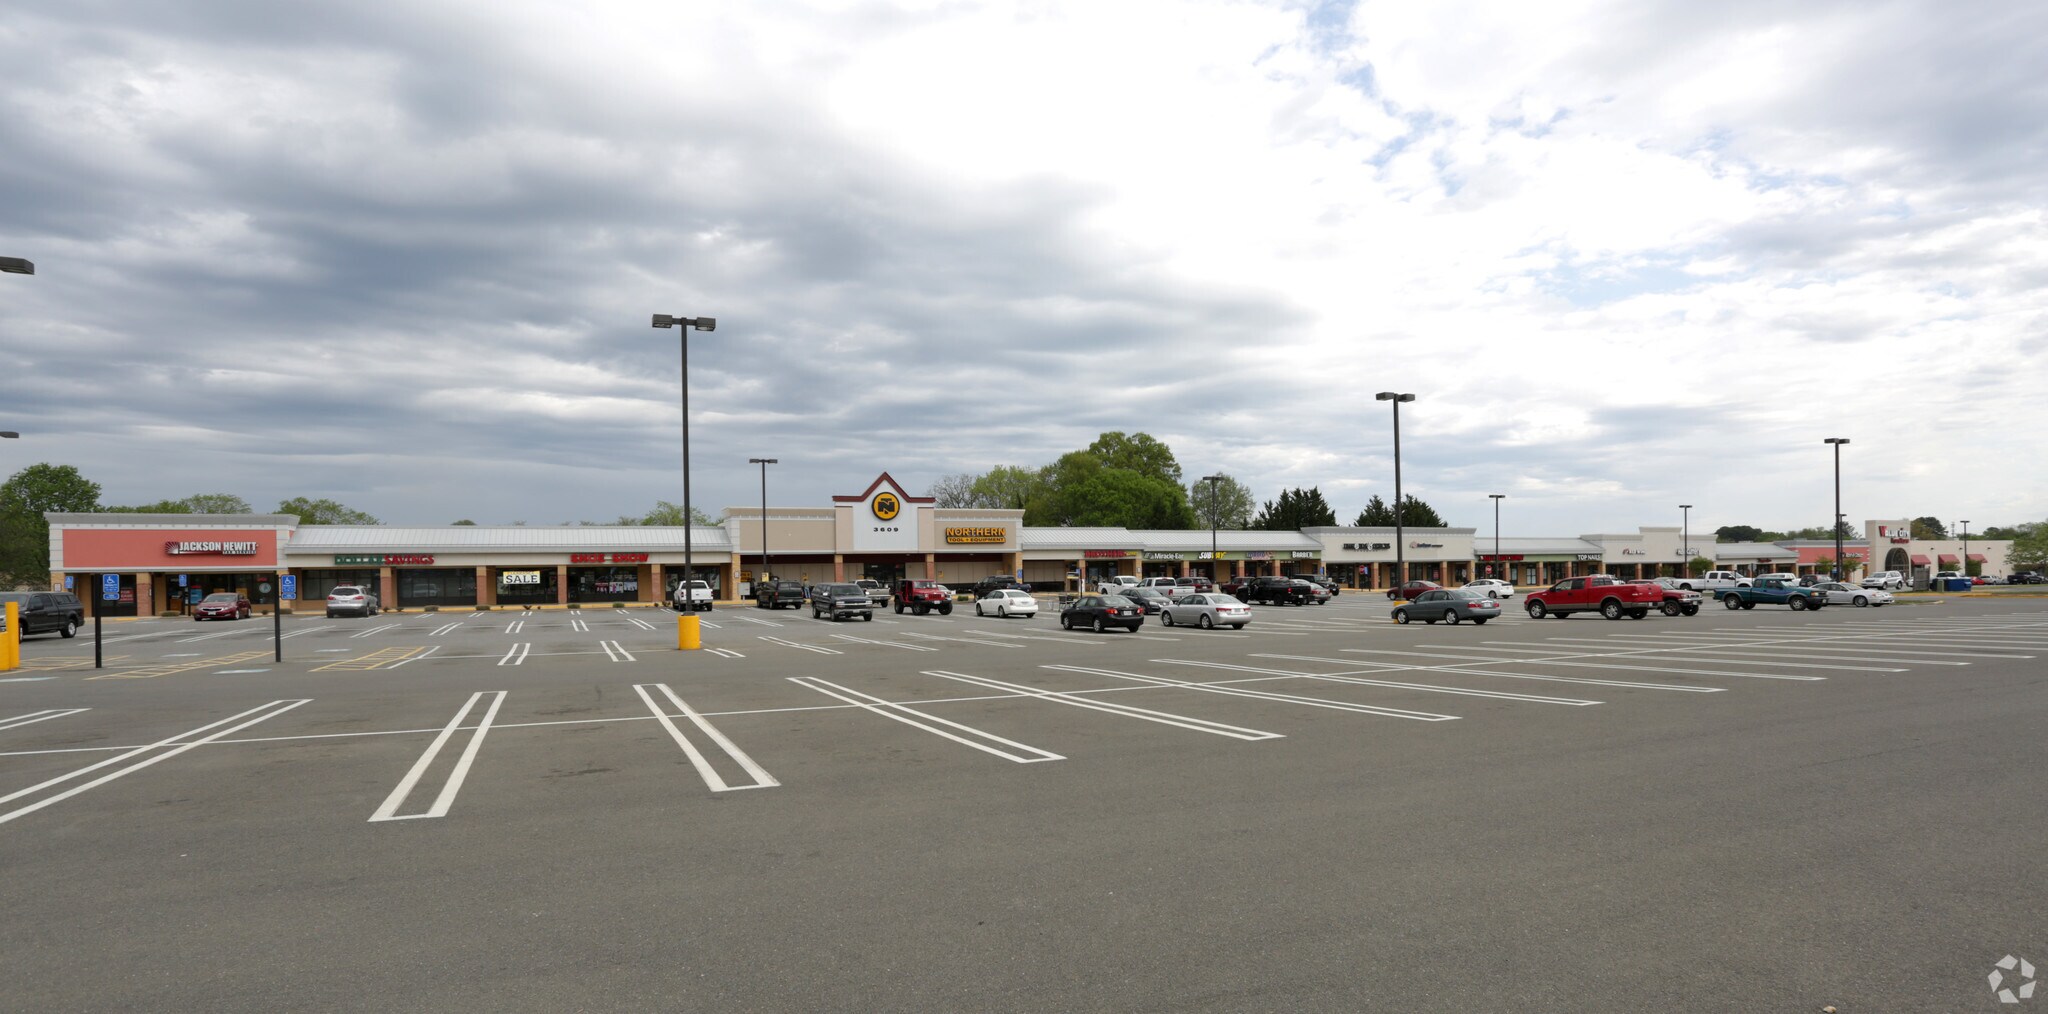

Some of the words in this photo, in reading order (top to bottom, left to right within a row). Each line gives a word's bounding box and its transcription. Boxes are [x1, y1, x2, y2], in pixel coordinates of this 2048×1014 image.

[946, 527, 1006, 536] NORTHERN
[180, 542, 221, 551] JACKSON
[223, 542, 257, 551] HEWITT
[570, 553, 606, 563] SHOE
[612, 553, 649, 562] SHOW
[506, 574, 538, 583] SALE
